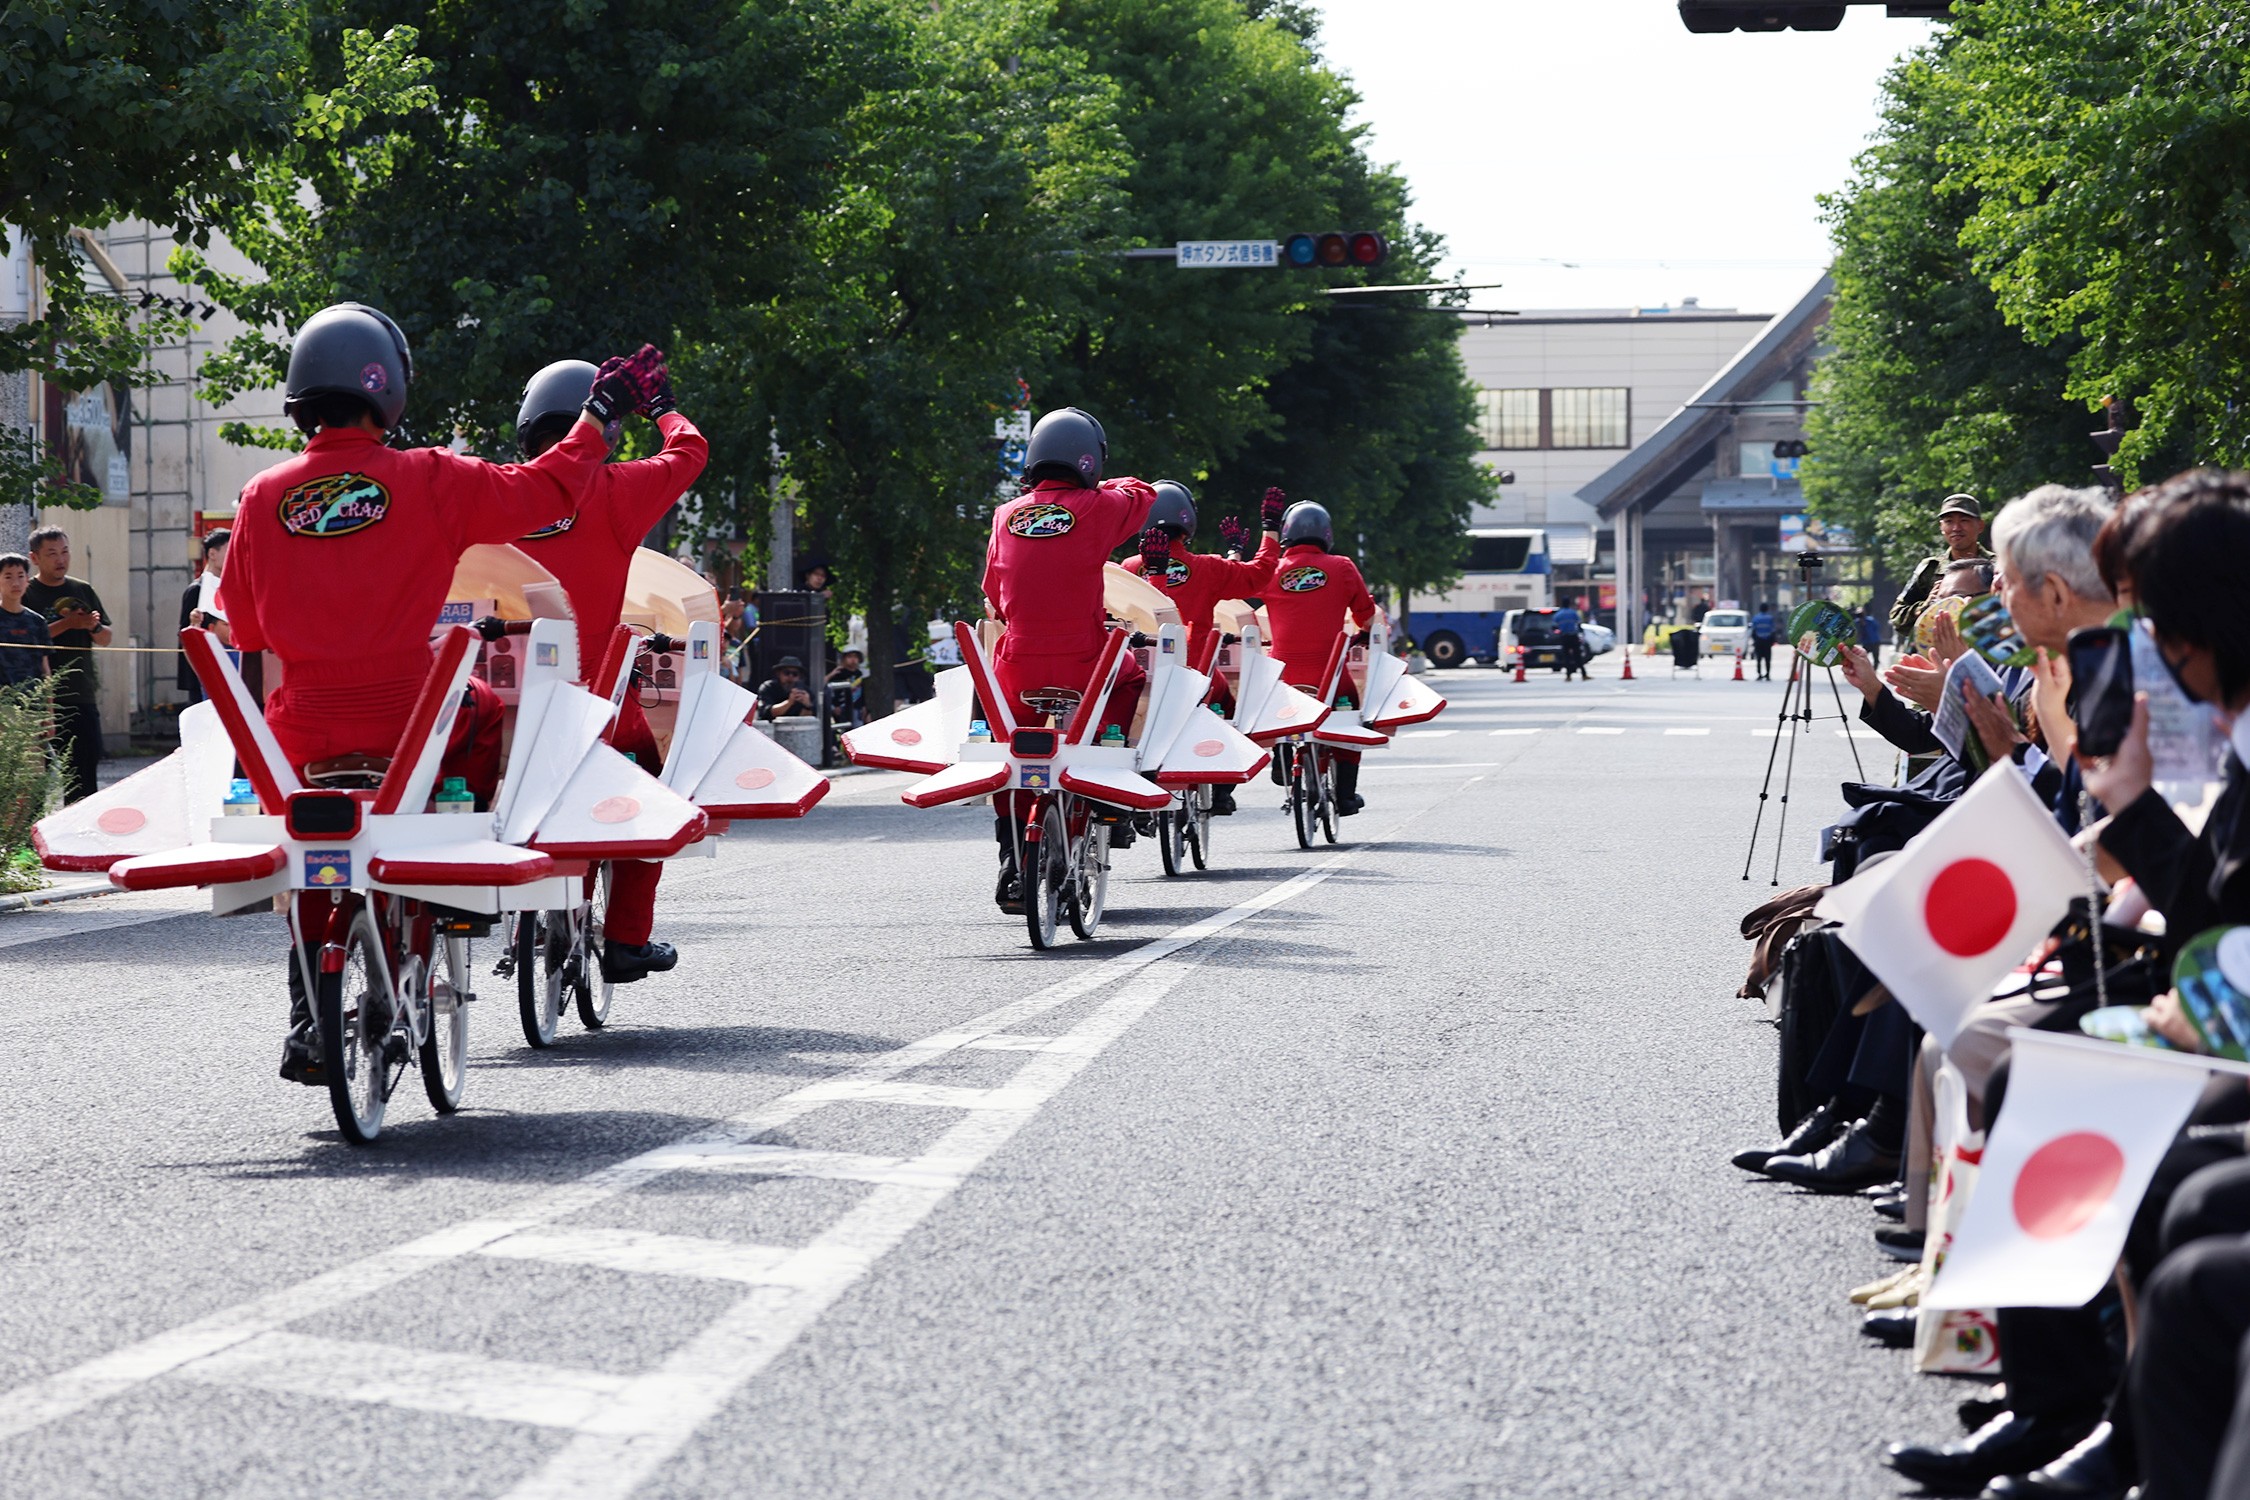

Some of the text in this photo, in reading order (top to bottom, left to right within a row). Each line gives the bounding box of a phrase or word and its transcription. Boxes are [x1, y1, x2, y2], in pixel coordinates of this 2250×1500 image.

[1181, 244, 1274, 263] 押ボタン式信号機
[286, 501, 385, 533] RED CRAB
[1008, 519, 1070, 534] RED CRAB
[441, 604, 471, 617] RAB
[306, 854, 350, 864] RedCrab
